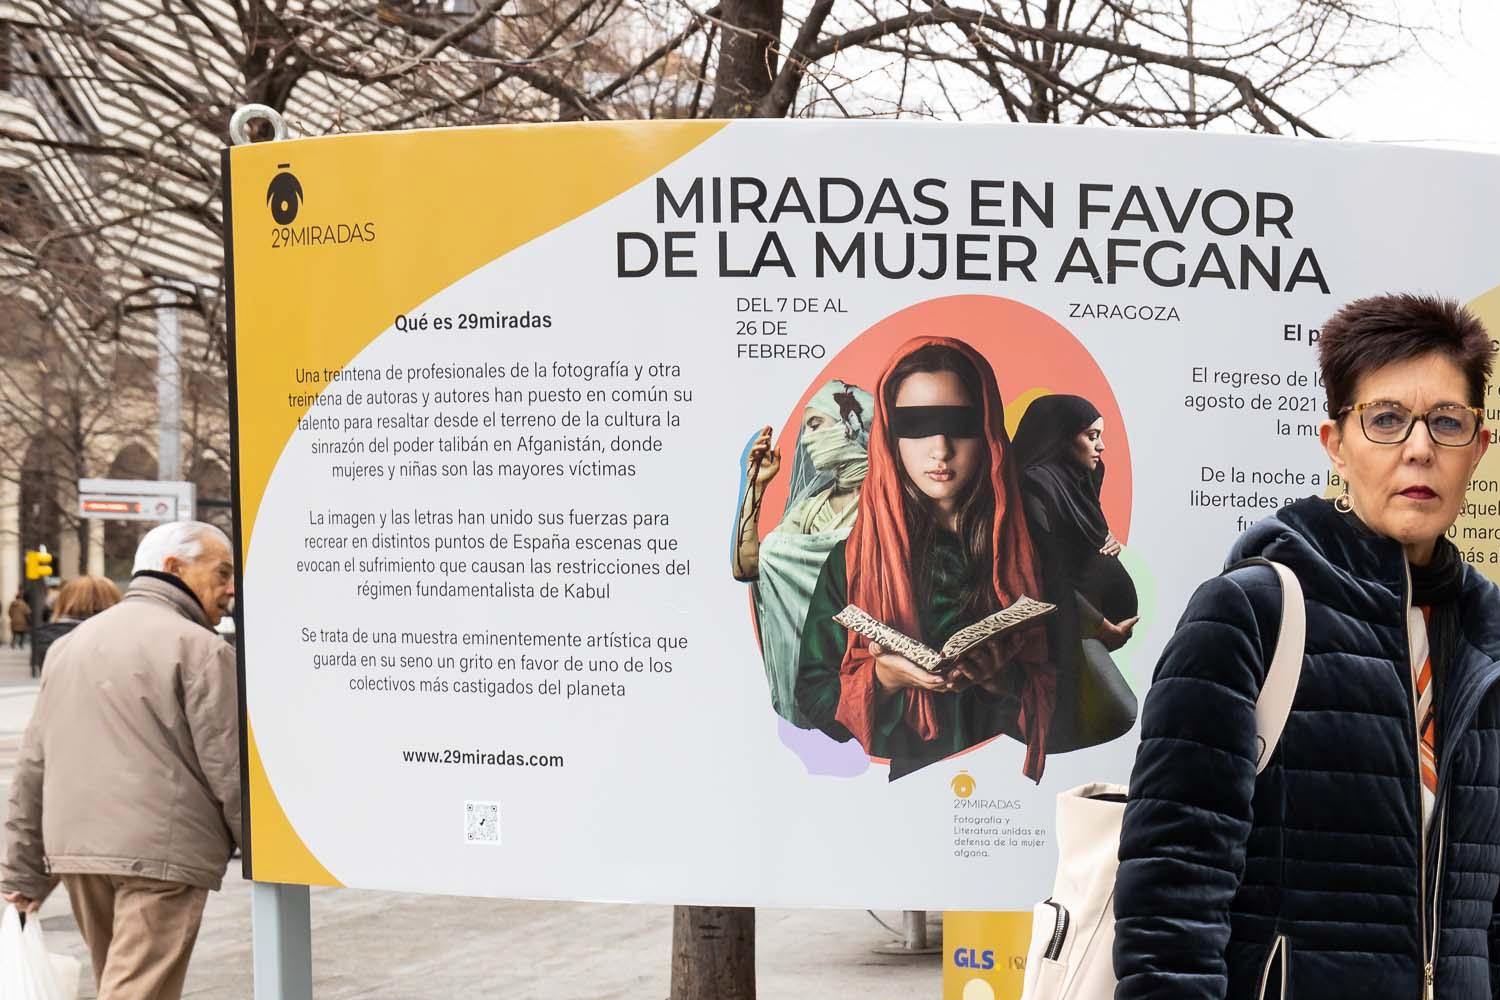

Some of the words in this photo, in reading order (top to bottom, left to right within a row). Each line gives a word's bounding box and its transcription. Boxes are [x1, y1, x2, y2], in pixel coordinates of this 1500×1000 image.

[656, 176, 949, 226] MIRADAS
[971, 179, 1054, 229] EN
[1079, 183, 1294, 239] FAVOR
[272, 222, 375, 248] 29MIRADAS
[617, 231, 698, 278] DE
[718, 231, 797, 278] LA
[815, 231, 1037, 282] MUJER
[1054, 237, 1331, 295] AFGANA
[737, 297, 773, 312] DEL
[777, 297, 788, 312] 7
[793, 298, 819, 312] DE
[823, 298, 848, 313] AL
[1069, 303, 1180, 322] ZARAGOZA
[395, 313, 428, 333] Qué
[433, 317, 453, 330] es
[458, 310, 552, 329] 29miradas
[736, 320, 757, 336] 26
[762, 321, 788, 336] DE
[1284, 324, 1301, 341] El
[737, 344, 826, 359] FEBRERO
[296, 368, 320, 383] Una
[323, 366, 381, 383] treintena
[385, 364, 403, 380] de
[407, 362, 506, 383] profesionales
[510, 362, 529, 378] de
[552, 360, 629, 382] fotografía
[648, 362, 680, 377] otra
[1192, 367, 1207, 383] El
[1214, 371, 1281, 388] regreso
[1286, 370, 1308, 387] de
[288, 391, 342, 407] treintena
[346, 389, 363, 406] de
[366, 390, 418, 405] autoras
[434, 388, 490, 404] autores
[494, 386, 523, 403] han
[528, 387, 582, 406] puesto
[586, 390, 606, 402] en
[611, 385, 668, 402] común
[673, 390, 692, 402] su
[1184, 394, 1245, 412] agosto
[1250, 393, 1272, 410] de
[1278, 396, 1316, 412] 2021
[297, 415, 340, 431] talento
[344, 417, 373, 433] para
[377, 412, 429, 429] resaltar
[434, 411, 479, 428] desde
[500, 412, 556, 427] terreno
[561, 410, 581, 427] de
[586, 410, 599, 427] la
[604, 410, 661, 427] cultura
[667, 410, 680, 427] la
[311, 437, 364, 454] sinrazón
[368, 437, 389, 453] del
[393, 436, 434, 456] poder
[438, 435, 488, 452] talibán
[493, 440, 512, 452] en
[517, 435, 605, 456] Afganistán,
[610, 435, 662, 452] donde
[332, 461, 384, 481] mujeres
[400, 460, 437, 477] niñas
[441, 464, 468, 476] son
[473, 460, 493, 476] las
[498, 464, 564, 480] mayores
[569, 459, 636, 476] víctimas
[1201, 466, 1225, 483] De
[1231, 467, 1245, 483] la
[1252, 468, 1305, 485] noche
[1191, 490, 1278, 509] libertades
[310, 510, 324, 525] La
[328, 510, 375, 529] imagen
[391, 509, 410, 525] las
[414, 508, 453, 525] letras
[458, 509, 485, 525] han
[490, 509, 533, 525] unido
[538, 513, 564, 525] sus
[568, 508, 628, 526] fuerzas
[633, 514, 669, 530] para
[304, 537, 348, 549] recrear
[352, 537, 368, 549] en
[372, 533, 430, 549] distintos
[435, 534, 485, 552] puntos
[489, 533, 508, 549] de
[513, 533, 570, 553] España
[575, 538, 642, 550] escenas
[647, 538, 678, 555] que
[297, 561, 340, 572] evocan
[359, 556, 435, 573] sufrimiento
[439, 561, 467, 577] que
[471, 561, 525, 574] causan
[530, 557, 552, 574] las
[557, 558, 660, 575] restricciones
[665, 559, 690, 576] del
[357, 580, 412, 600] régimen
[416, 580, 534, 598] fundamentalista
[539, 582, 559, 598] de
[564, 582, 610, 599] Kabul
[301, 627, 317, 642] Se
[320, 629, 348, 643] trata
[352, 627, 368, 643] de
[372, 632, 397, 644] una
[401, 630, 458, 645] muestra
[462, 630, 582, 647] eminentemente
[586, 631, 651, 648] artística
[657, 636, 688, 652] que
[313, 651, 357, 670] guarda
[360, 655, 376, 667] en
[380, 656, 396, 668] su
[400, 656, 433, 668] seno
[437, 657, 455, 669] un
[459, 653, 493, 673] grito
[497, 658, 516, 670] en
[521, 654, 559, 671] favor
[564, 655, 583, 672] de
[589, 660, 619, 672] uno
[624, 656, 644, 673] de
[649, 656, 673, 673] los
[349, 675, 416, 692] colectivos
[420, 676, 449, 693] más
[453, 677, 534, 698] castigados
[538, 679, 561, 695] del
[567, 680, 625, 700] planeta
[403, 749, 564, 767] www.29miradas.com
[954, 799, 1021, 810] 29MIRADAS
[954, 815, 1001, 826] Fotografía
[954, 826, 999, 836] Literatura
[1001, 827, 1032, 836] unidas
[954, 837, 993, 848] defensa
[993, 837, 1006, 847] de
[1009, 837, 1018, 847] la
[1021, 839, 1045, 848] mujer
[954, 947, 995, 970] GLS
